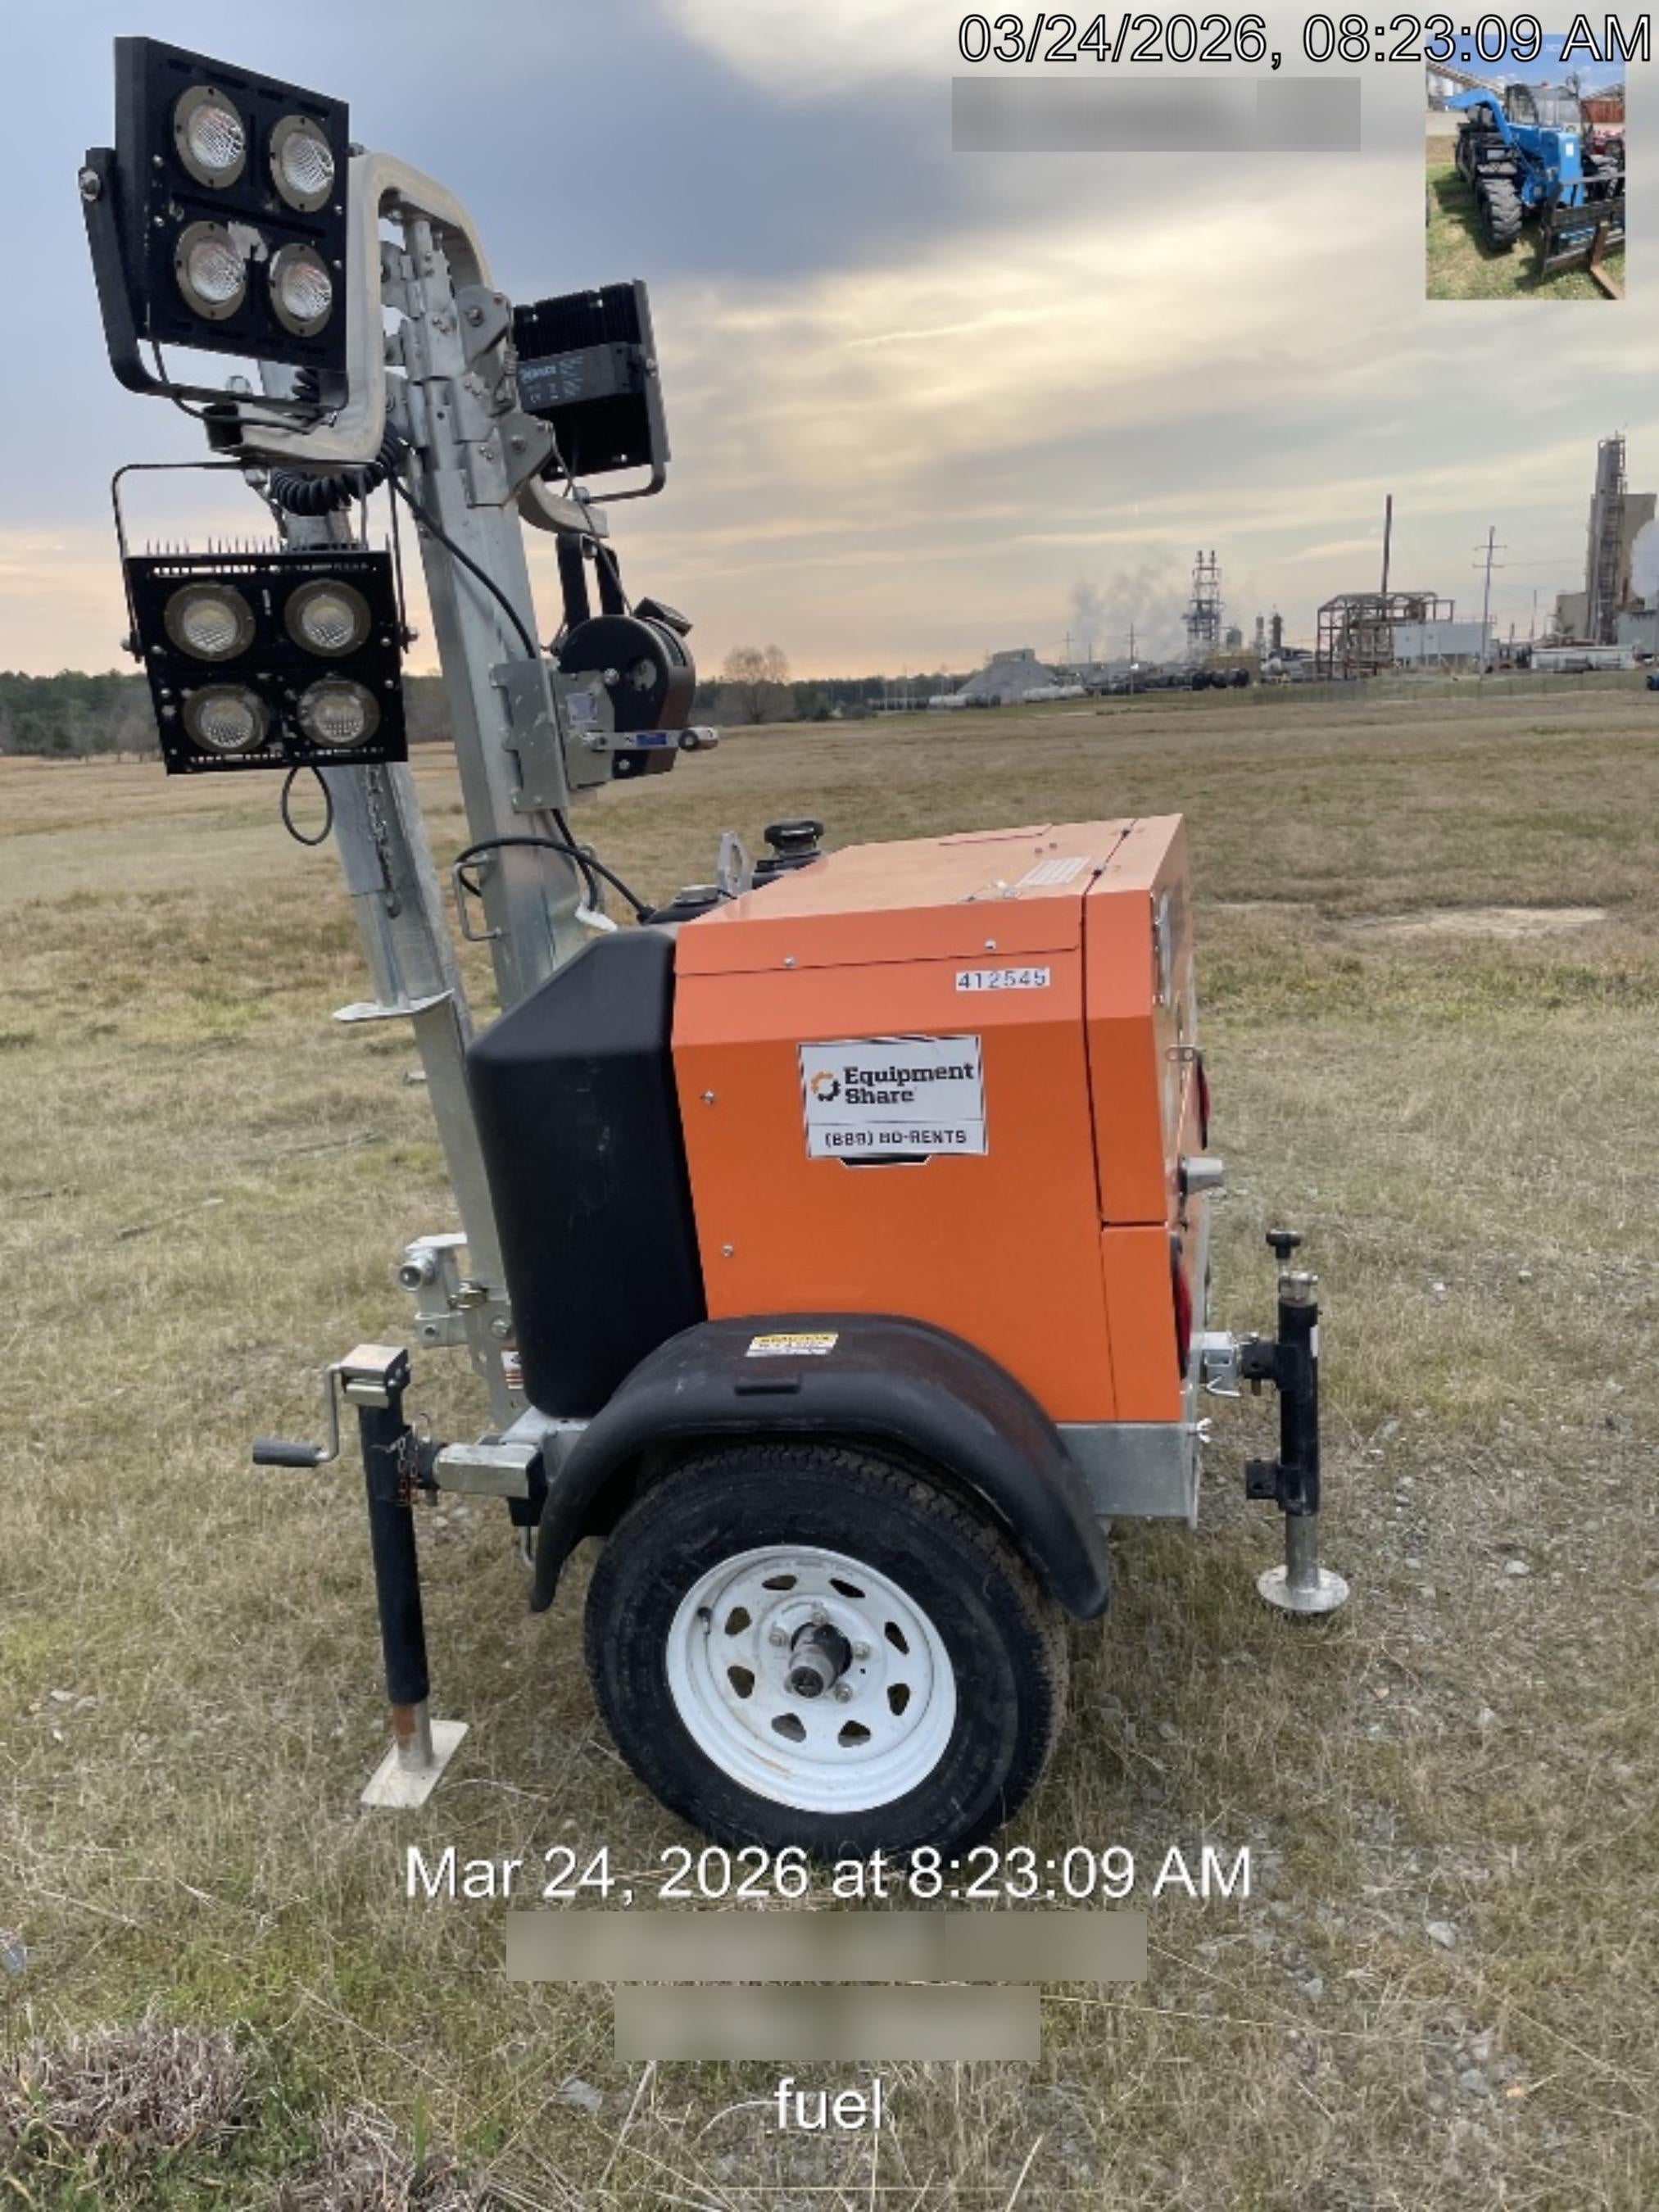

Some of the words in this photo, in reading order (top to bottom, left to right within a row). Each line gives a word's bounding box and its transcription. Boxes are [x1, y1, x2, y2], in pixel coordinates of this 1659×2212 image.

[958, 971, 1046, 988] 412545
[844, 1063, 974, 1086] Equipment
[845, 1088, 915, 1104] Share
